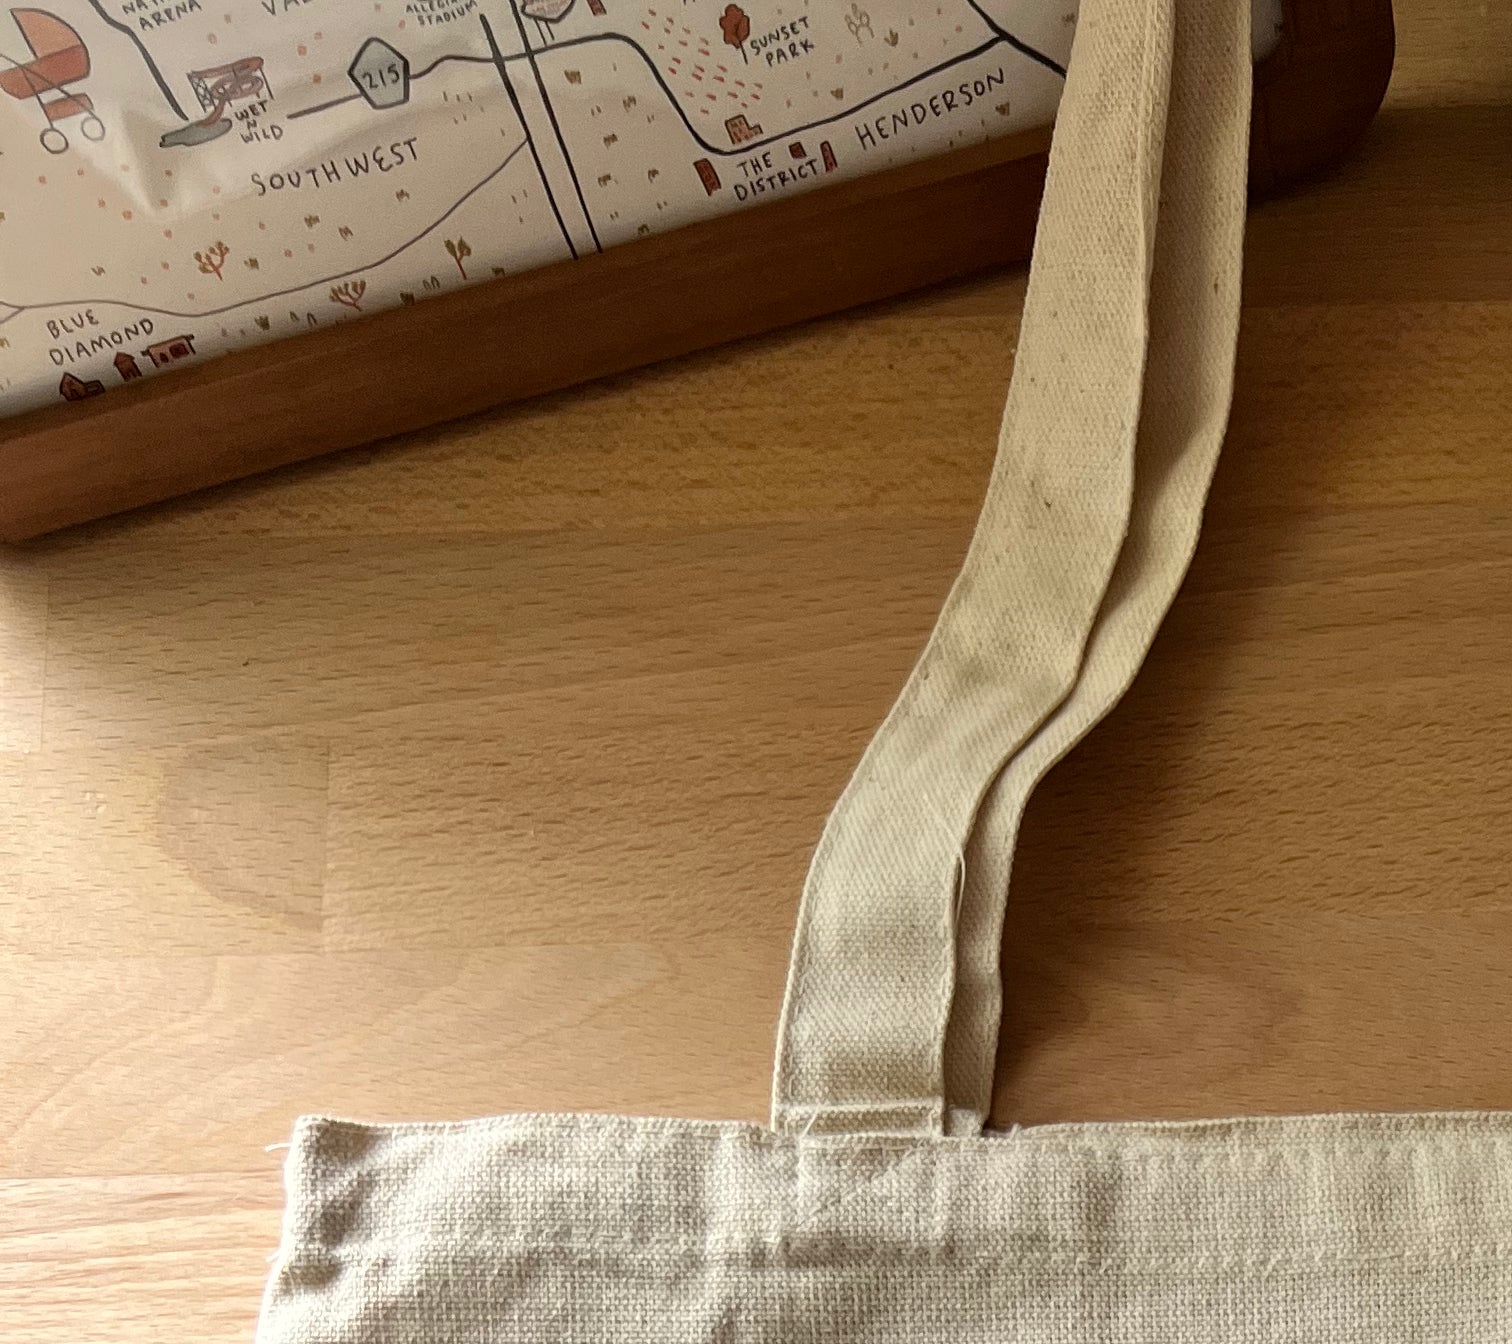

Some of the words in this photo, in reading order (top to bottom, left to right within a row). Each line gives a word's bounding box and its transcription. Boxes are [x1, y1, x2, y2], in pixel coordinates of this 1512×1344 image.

[139, 0, 202, 31] ARENA
[417, 0, 478, 26] STADIUM
[750, 16, 810, 56] SUNSET
[765, 39, 815, 68] PARK
[362, 63, 401, 90] 215
[234, 100, 268, 121] WET
[854, 67, 1005, 151] HENDERSON
[240, 124, 284, 144] WILD
[737, 151, 773, 179] THE
[733, 159, 818, 202] DISTRICT
[46, 308, 100, 340] BLUE
[49, 318, 154, 366] DIAMOND
